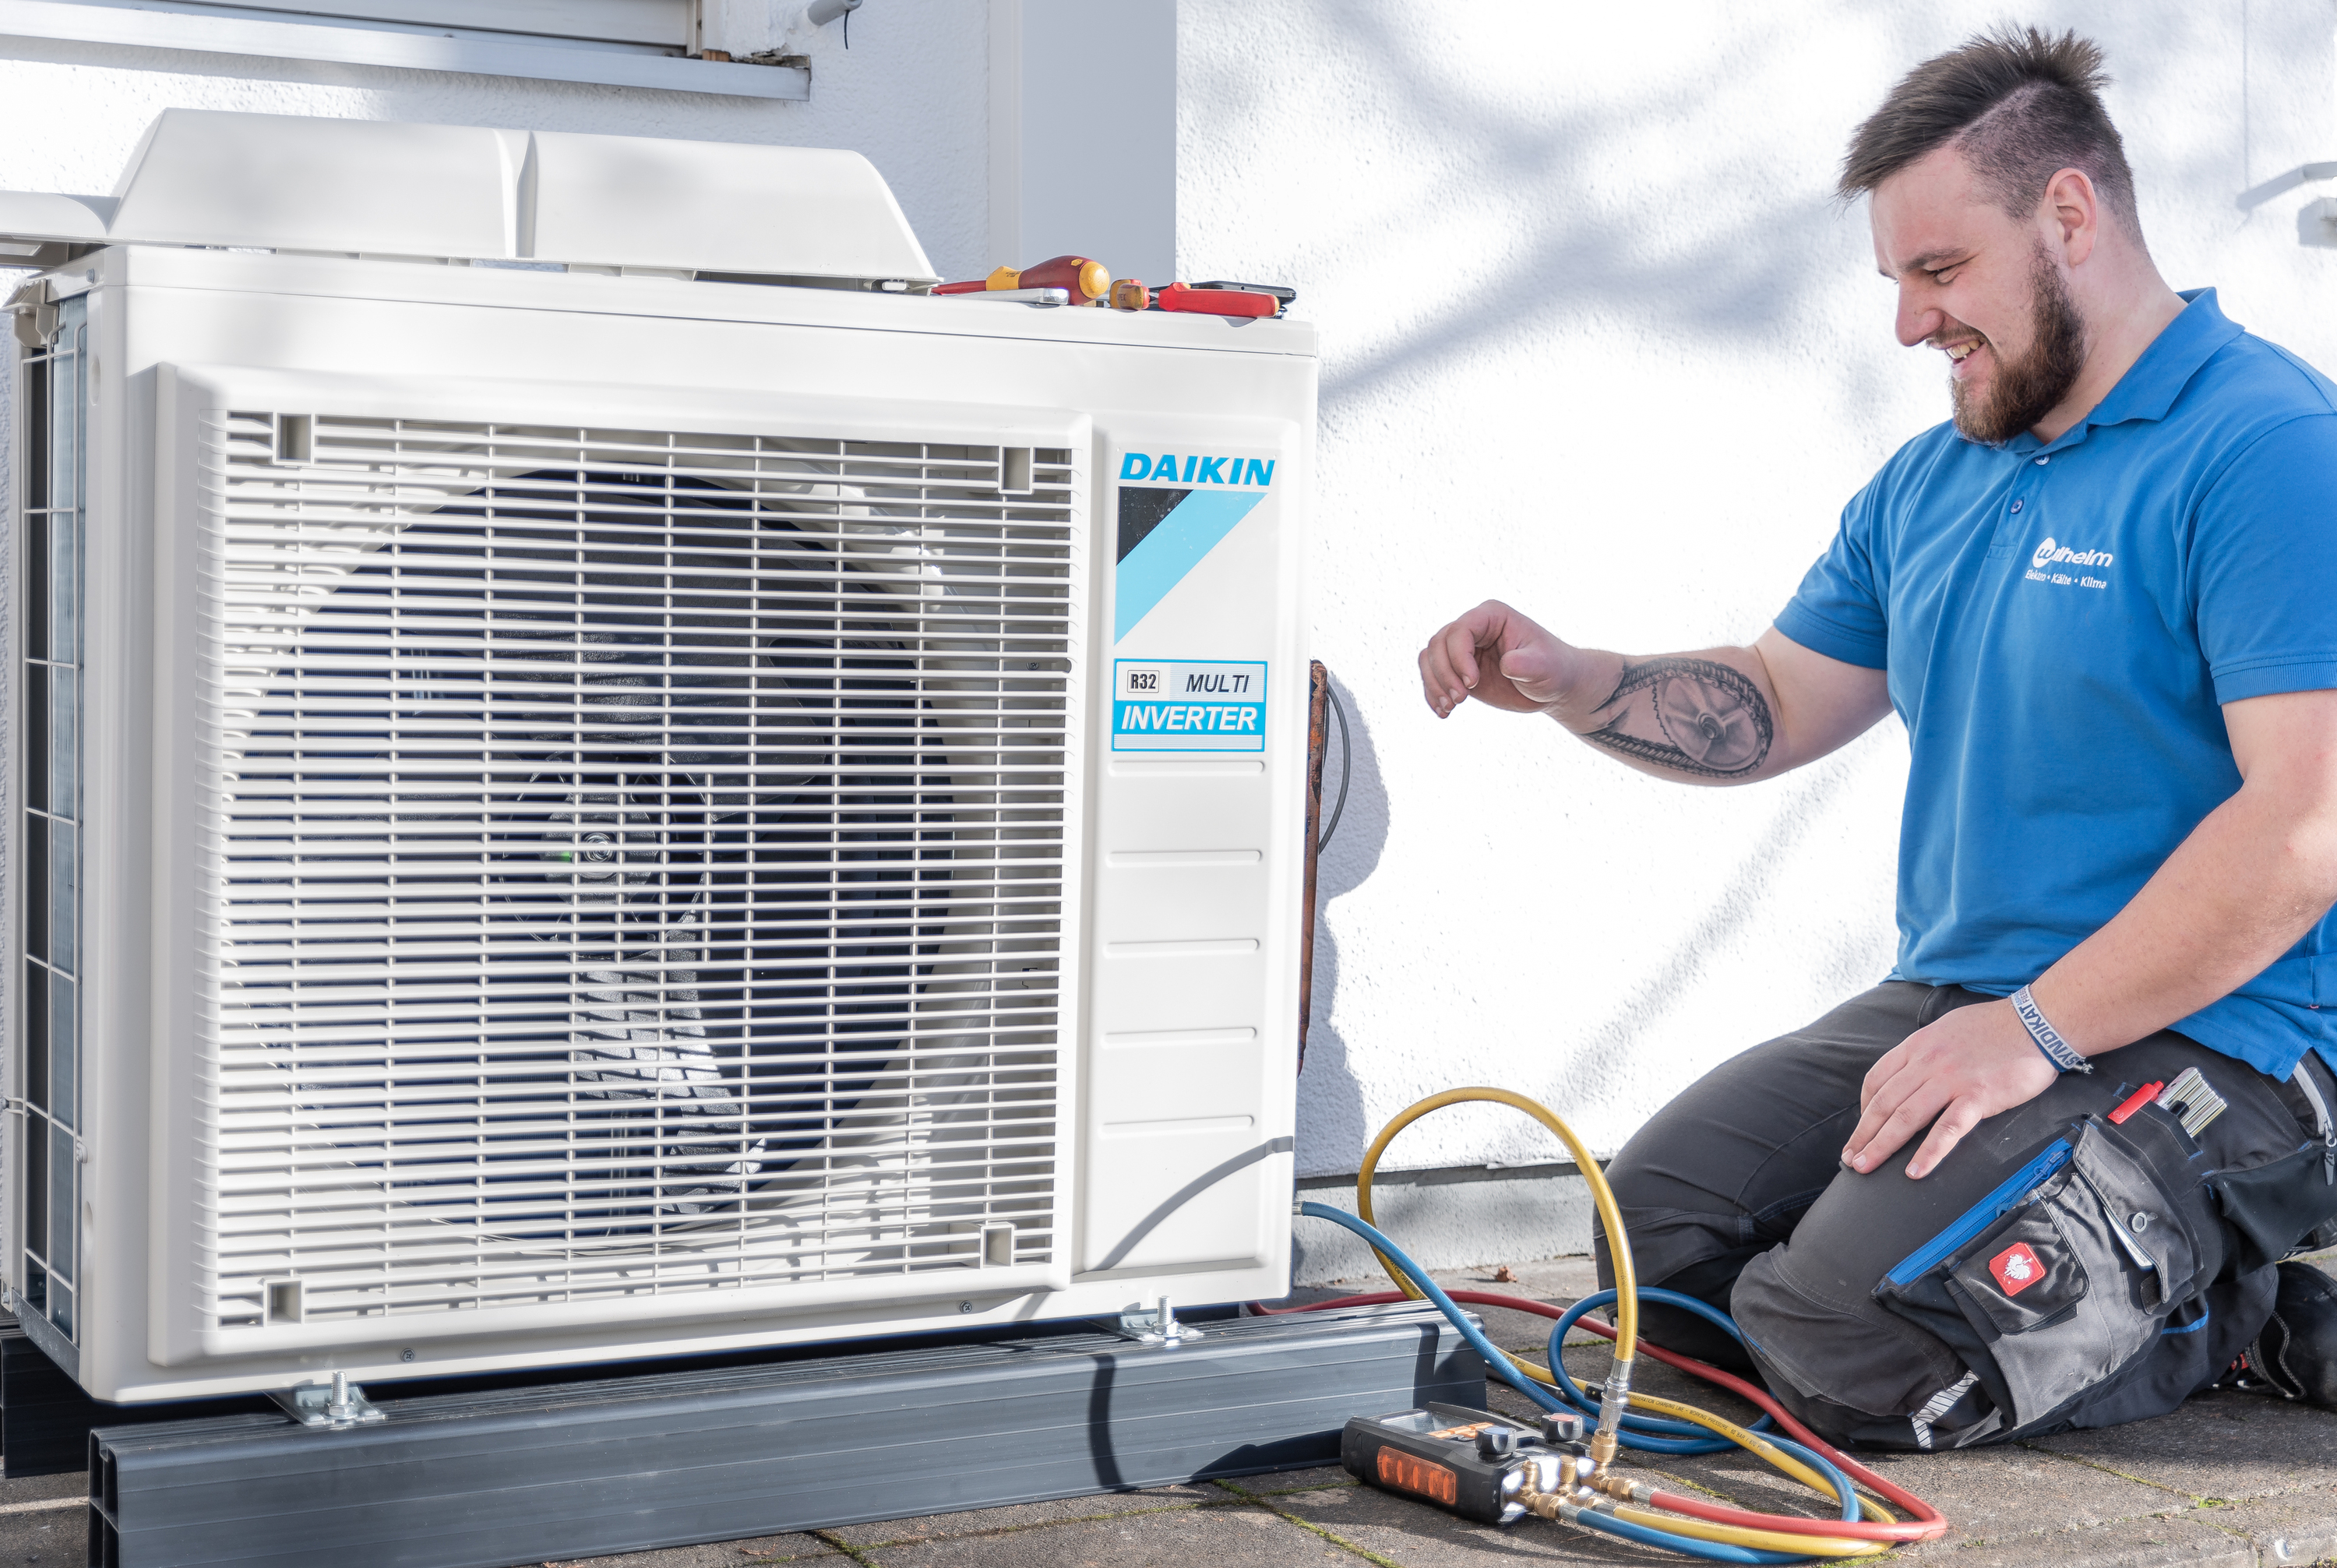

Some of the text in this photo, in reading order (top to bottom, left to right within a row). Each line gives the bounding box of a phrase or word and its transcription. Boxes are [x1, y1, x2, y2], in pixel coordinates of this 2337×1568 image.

[1118, 452, 1275, 486] DAIKIN
[2050, 573, 2072, 585] Kälte
[2080, 576, 2107, 589] Klima
[1130, 673, 1157, 689] R32
[1185, 674, 1250, 693] MULTI
[1121, 705, 1257, 731] INVERTER
[2018, 1003, 2081, 1066] SYNDIKAT
[1449, 1306, 1482, 1344] REFRIGERATION
[1480, 1341, 1505, 1367] CHARGING
[1503, 1365, 1516, 1378] LINE
[1517, 1378, 1542, 1399] WORKING
[1655, 1401, 1675, 1409] CHARGING
[1689, 1410, 1707, 1420] WORKING
[1708, 1417, 1729, 1431] PRESSURE
